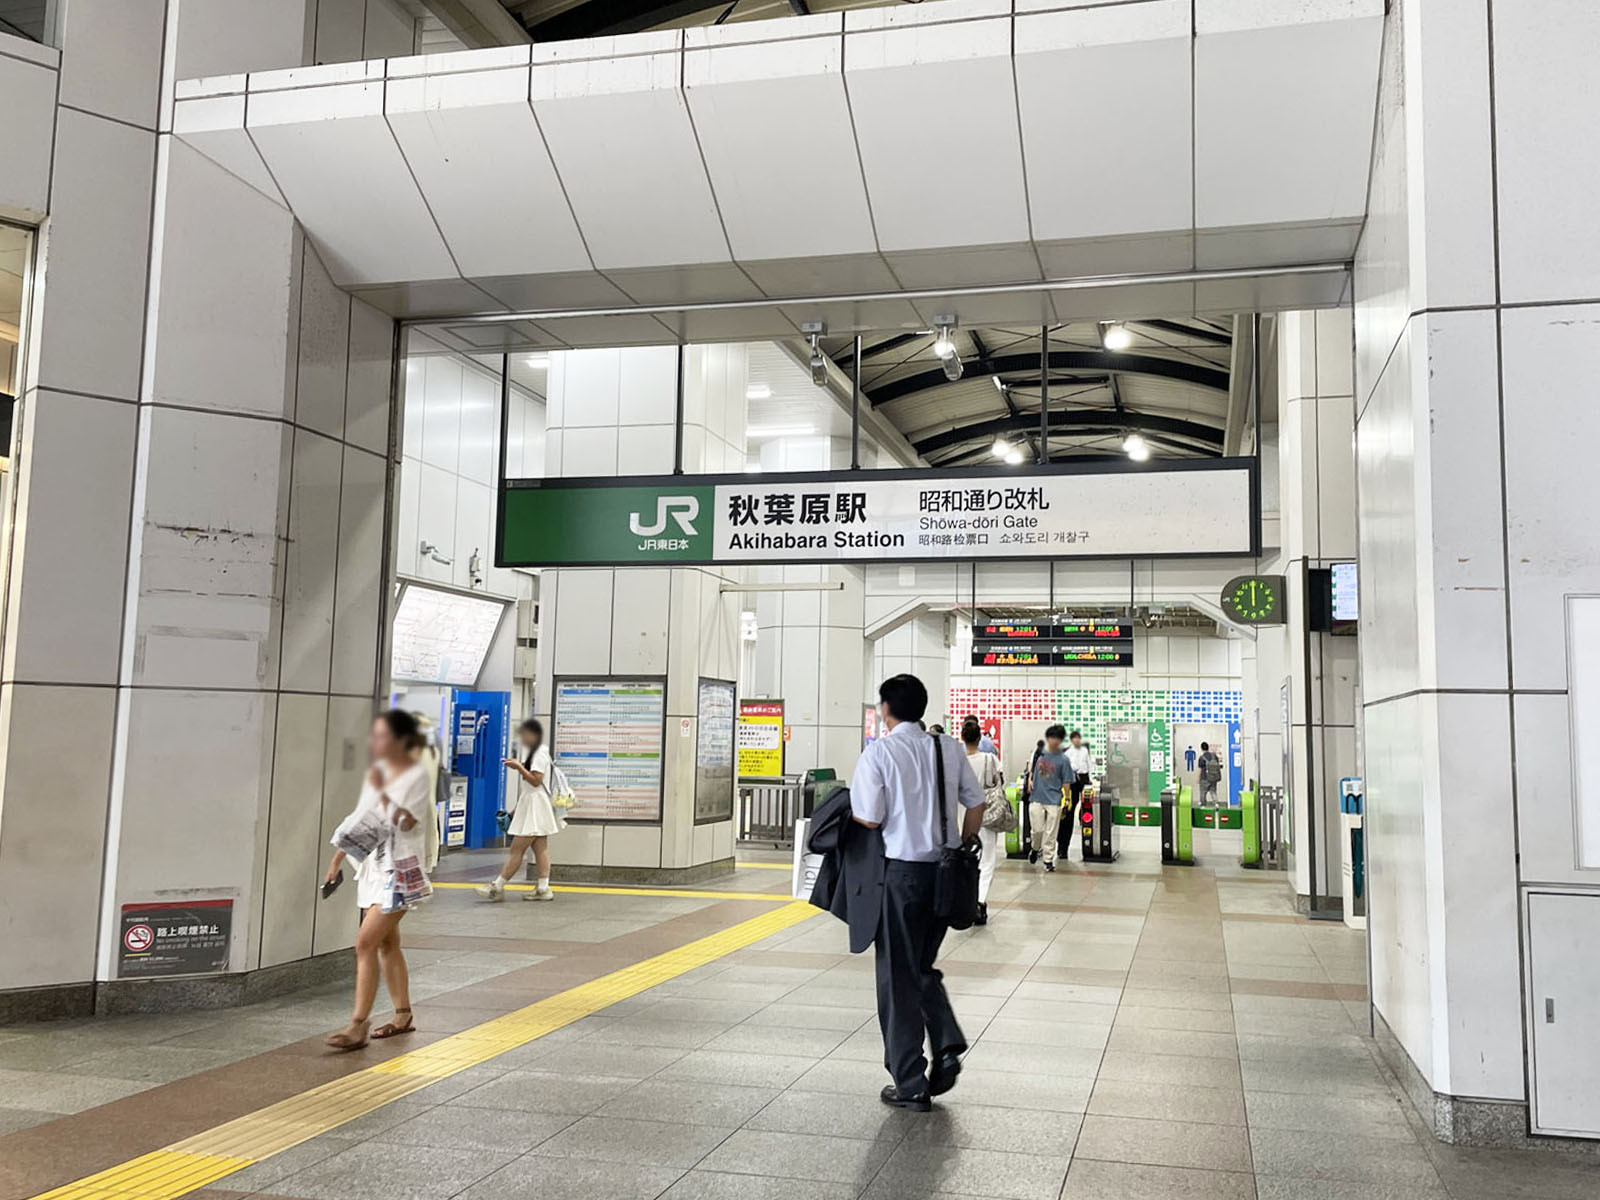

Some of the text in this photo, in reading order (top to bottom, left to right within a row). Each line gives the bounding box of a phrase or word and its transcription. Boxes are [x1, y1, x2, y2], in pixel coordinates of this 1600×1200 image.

[919, 486, 1050, 513] 昭和通り改札
[629, 495, 700, 536] JR
[728, 492, 868, 526] 秋葉原駅
[1003, 514, 1038, 529] Gate
[637, 538, 690, 551] JR東日本
[728, 529, 905, 550] Akihabara Station
[999, 531, 1091, 545] 쇼와도리 개찰구
[156, 924, 219, 937] 路上喫煙禁止
